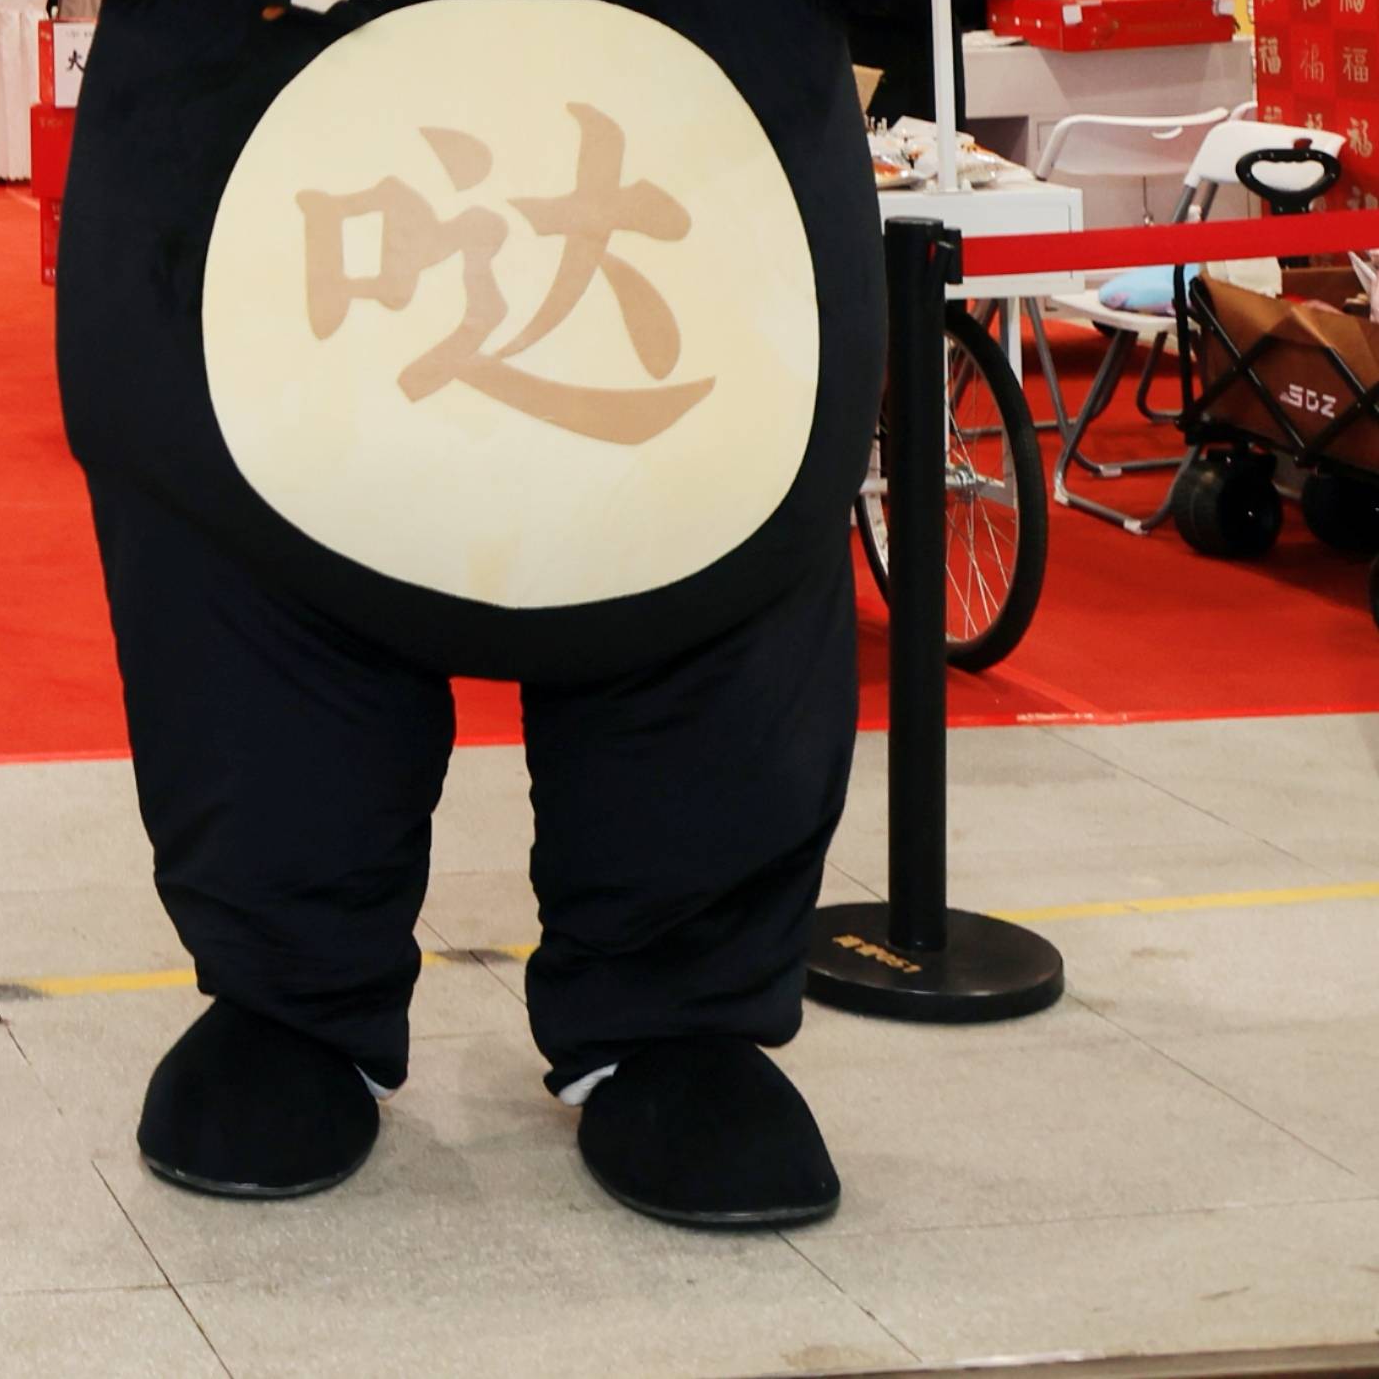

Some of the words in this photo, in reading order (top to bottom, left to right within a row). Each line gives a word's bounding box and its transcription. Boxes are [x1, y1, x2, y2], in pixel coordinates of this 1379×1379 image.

[1256, 34, 1281, 75] 福
[1341, 46, 1370, 83] 福
[296, 101, 716, 446] 哒
